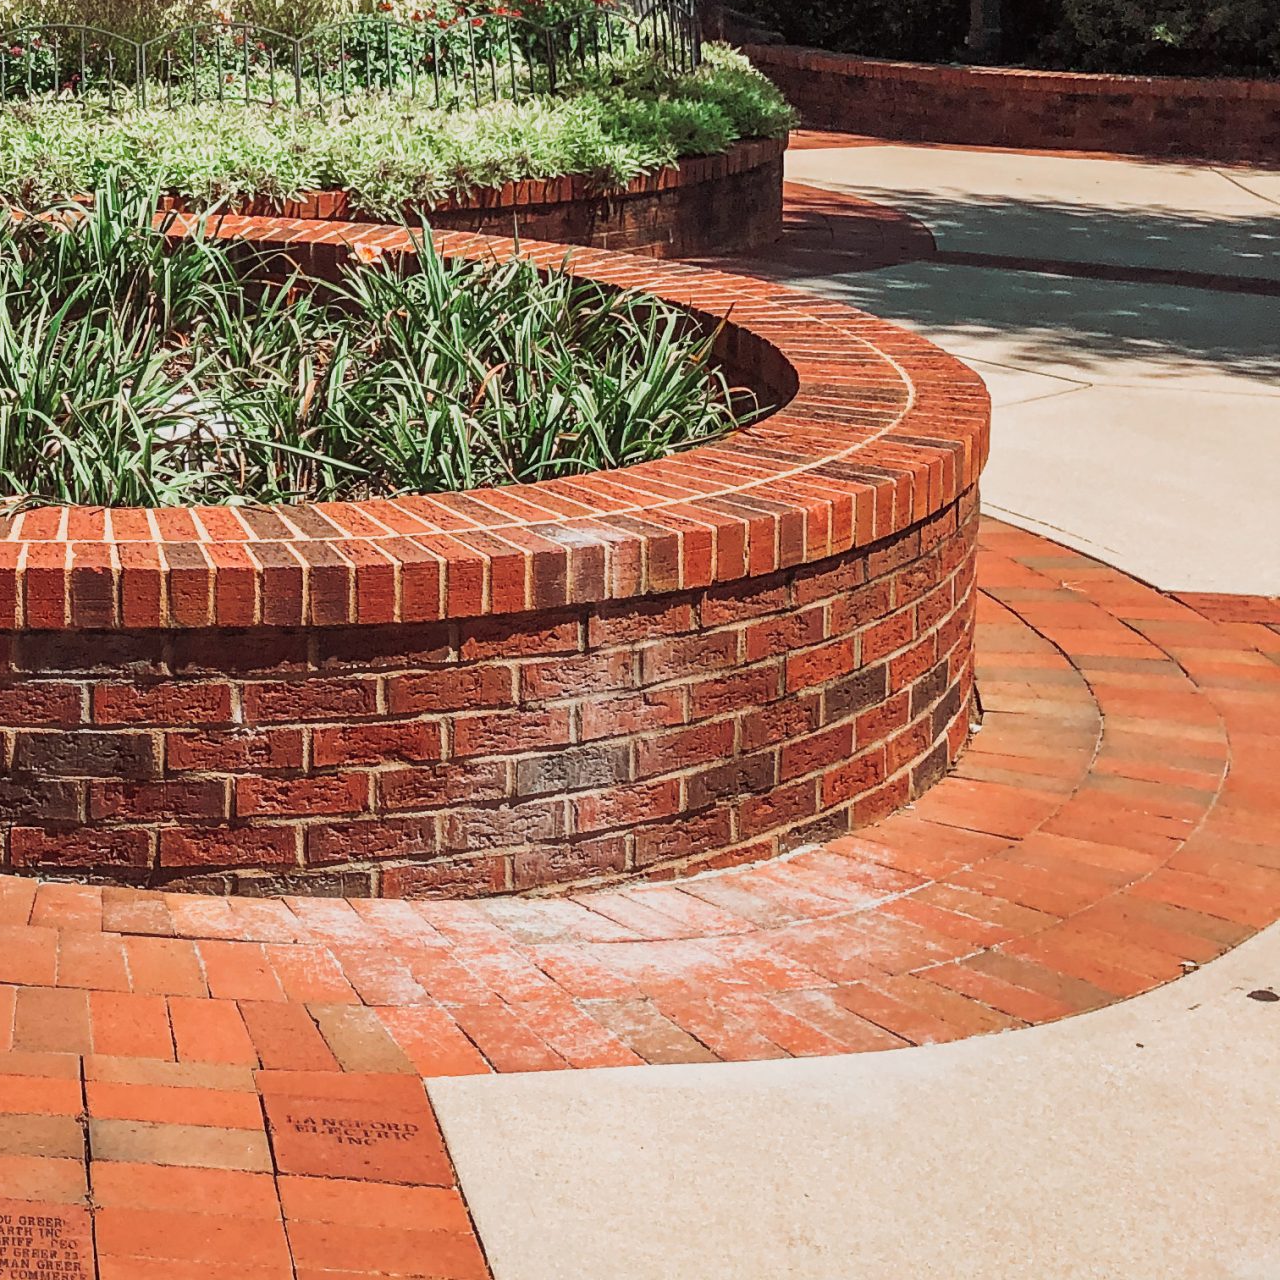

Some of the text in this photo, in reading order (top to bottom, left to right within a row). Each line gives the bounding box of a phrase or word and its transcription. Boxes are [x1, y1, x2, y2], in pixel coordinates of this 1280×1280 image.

[336, 1136, 376, 1145] INC
[39, 1228, 62, 1238] INC
[13, 1247, 58, 1259] GREER
[36, 1260, 81, 1272] GREER
